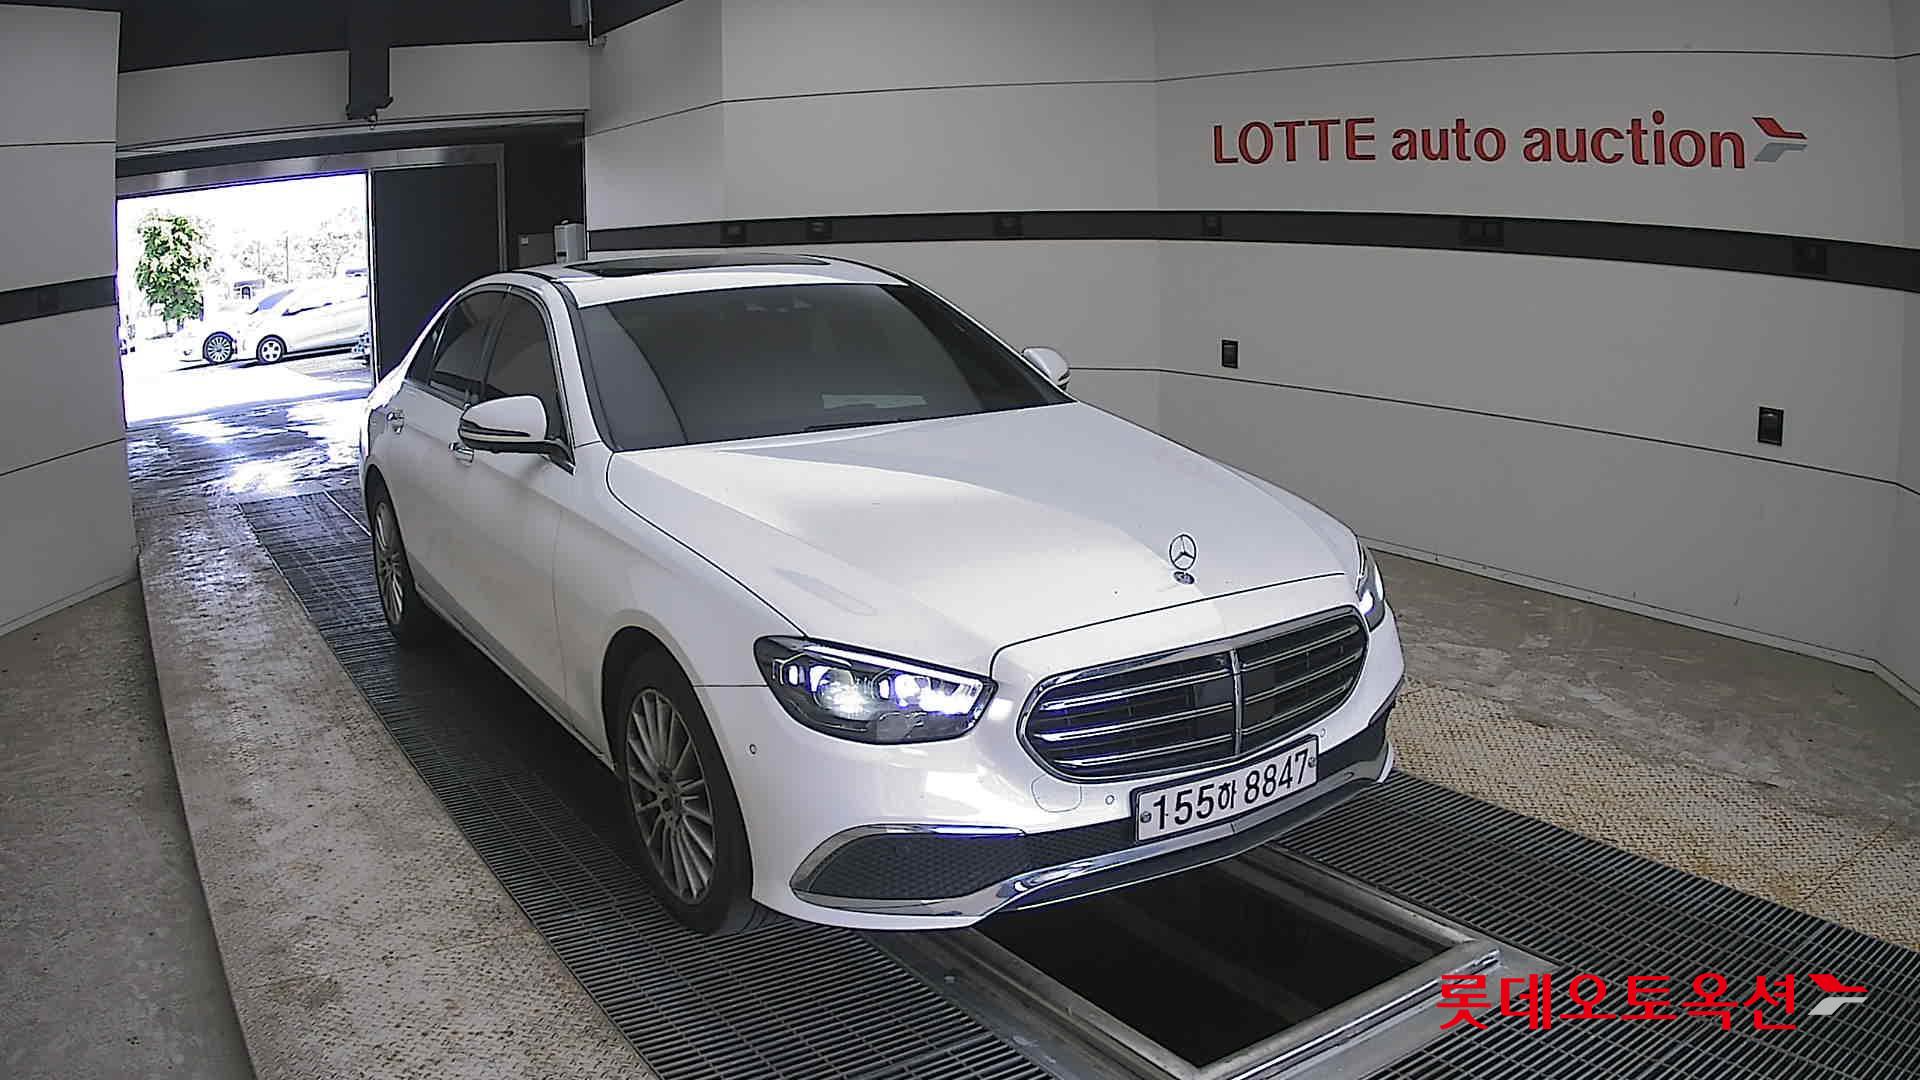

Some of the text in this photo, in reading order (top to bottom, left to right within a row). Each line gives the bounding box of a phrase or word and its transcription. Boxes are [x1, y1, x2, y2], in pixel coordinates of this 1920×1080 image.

[1212, 110, 1746, 169] LOTTE auto auction
[1152, 748, 1309, 830] 155하 8847
